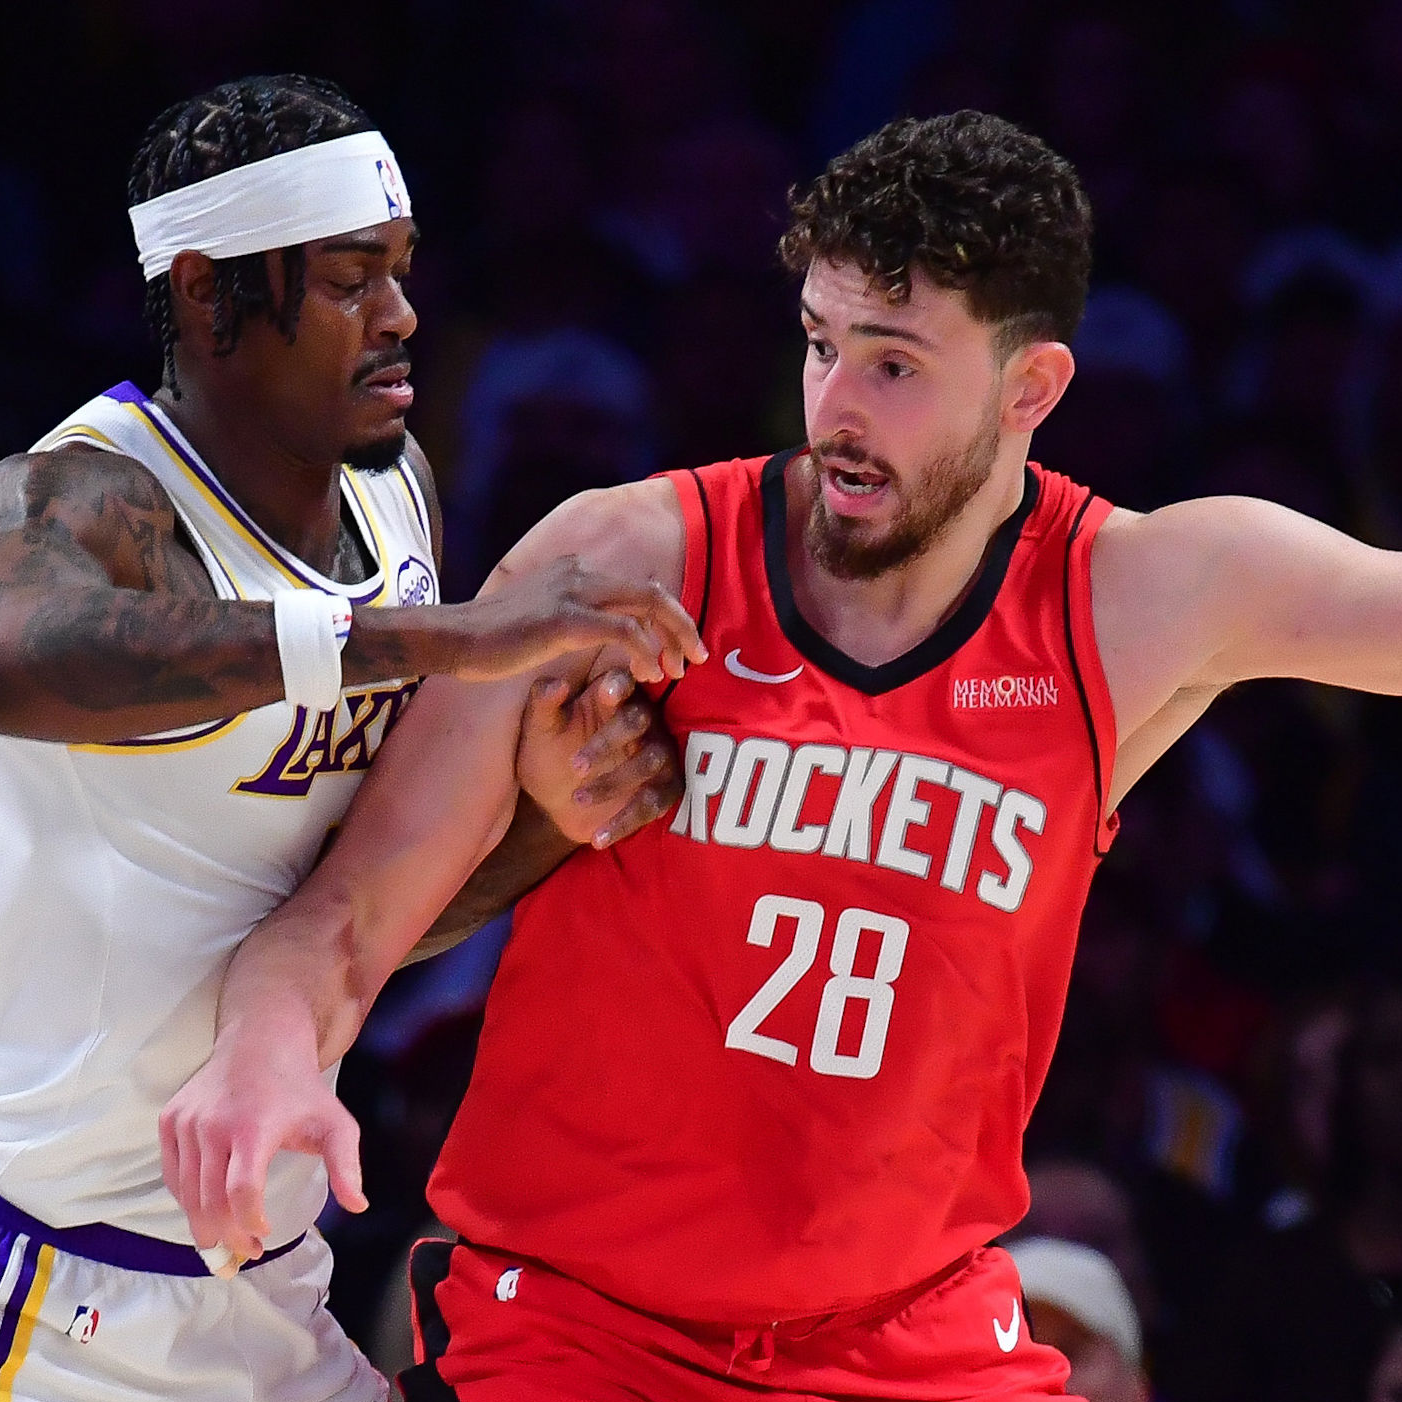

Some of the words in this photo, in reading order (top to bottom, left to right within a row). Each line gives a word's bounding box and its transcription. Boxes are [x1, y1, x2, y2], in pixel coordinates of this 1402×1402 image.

[953, 675, 1057, 695] MEMORIAL
[953, 689, 1059, 708] HERMANN
[669, 731, 1047, 913] ROCKETS
[725, 894, 910, 1079] 28
